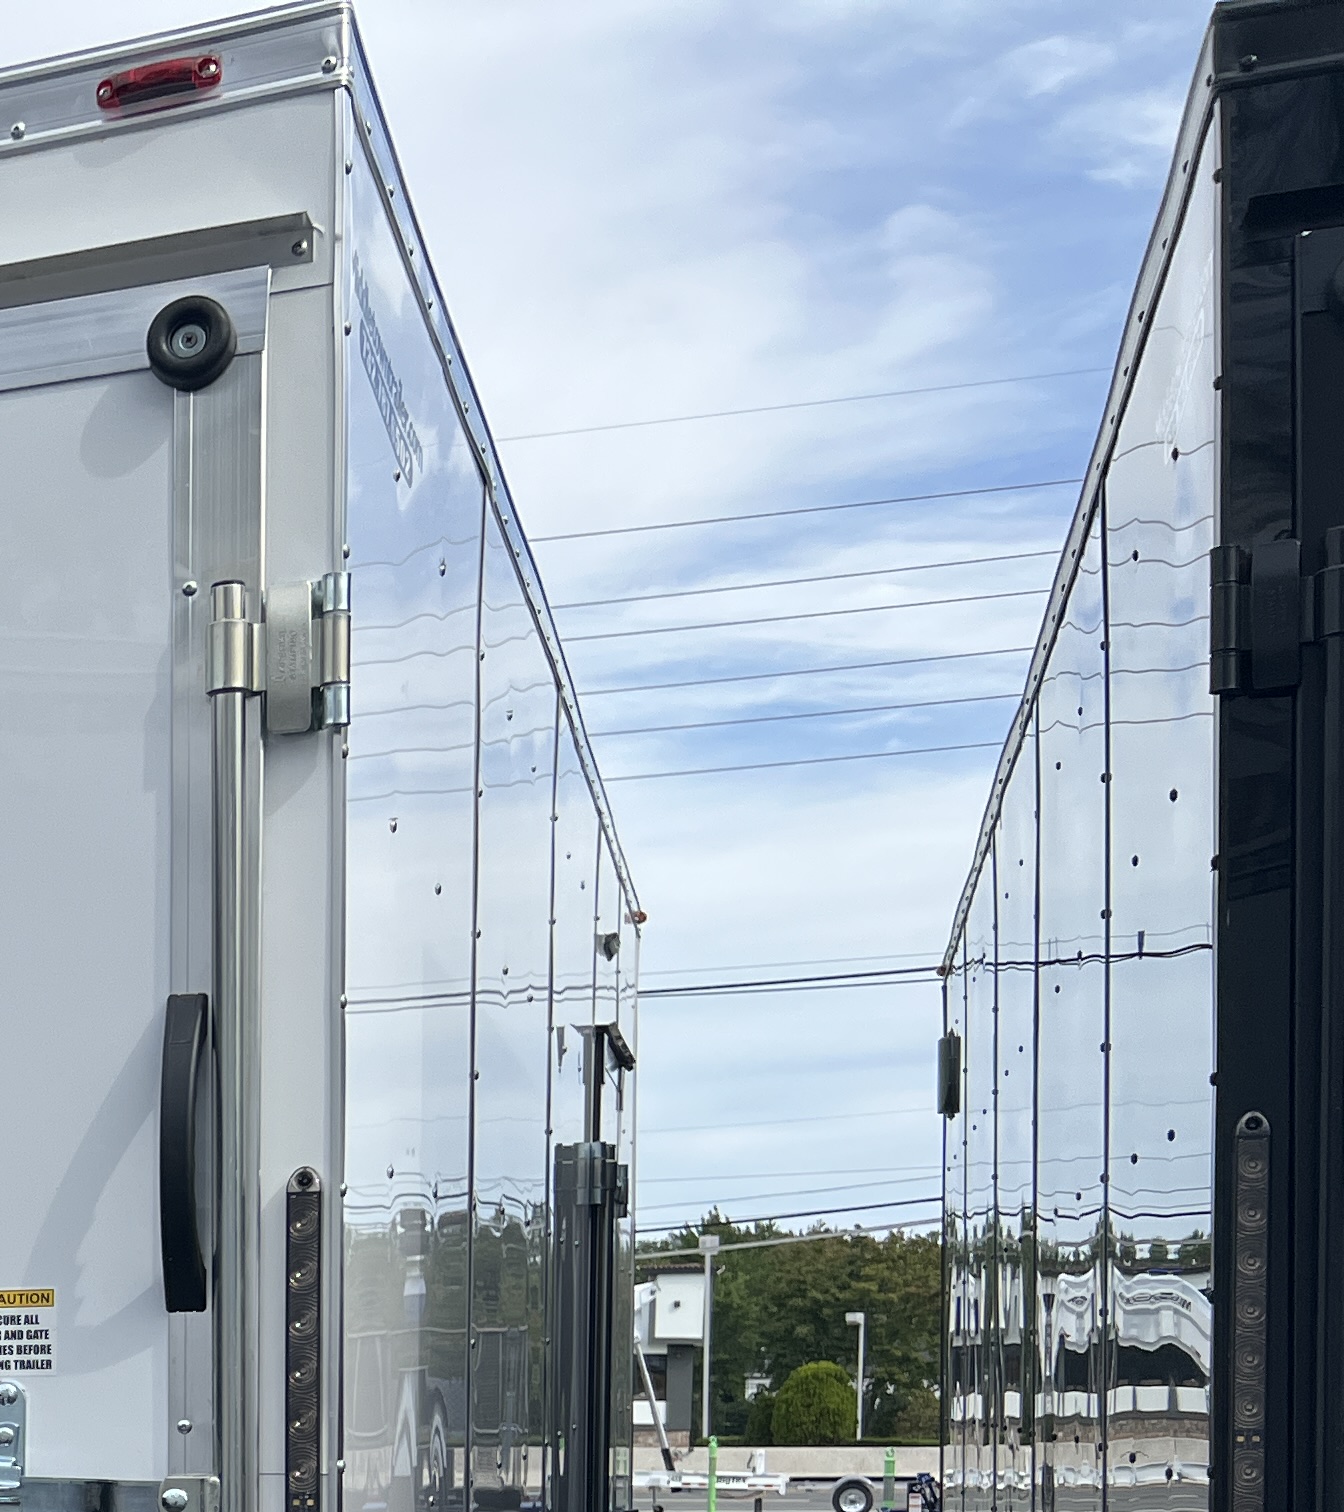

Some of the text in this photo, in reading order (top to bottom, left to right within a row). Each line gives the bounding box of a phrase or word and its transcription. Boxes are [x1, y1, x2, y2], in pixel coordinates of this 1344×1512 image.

[23, 1314, 40, 1325] ALL
[3, 1330, 24, 1341] AND
[25, 1329, 50, 1340] GATE
[15, 1344, 52, 1355] BEFORE
[14, 1359, 52, 1370] TRAILER
